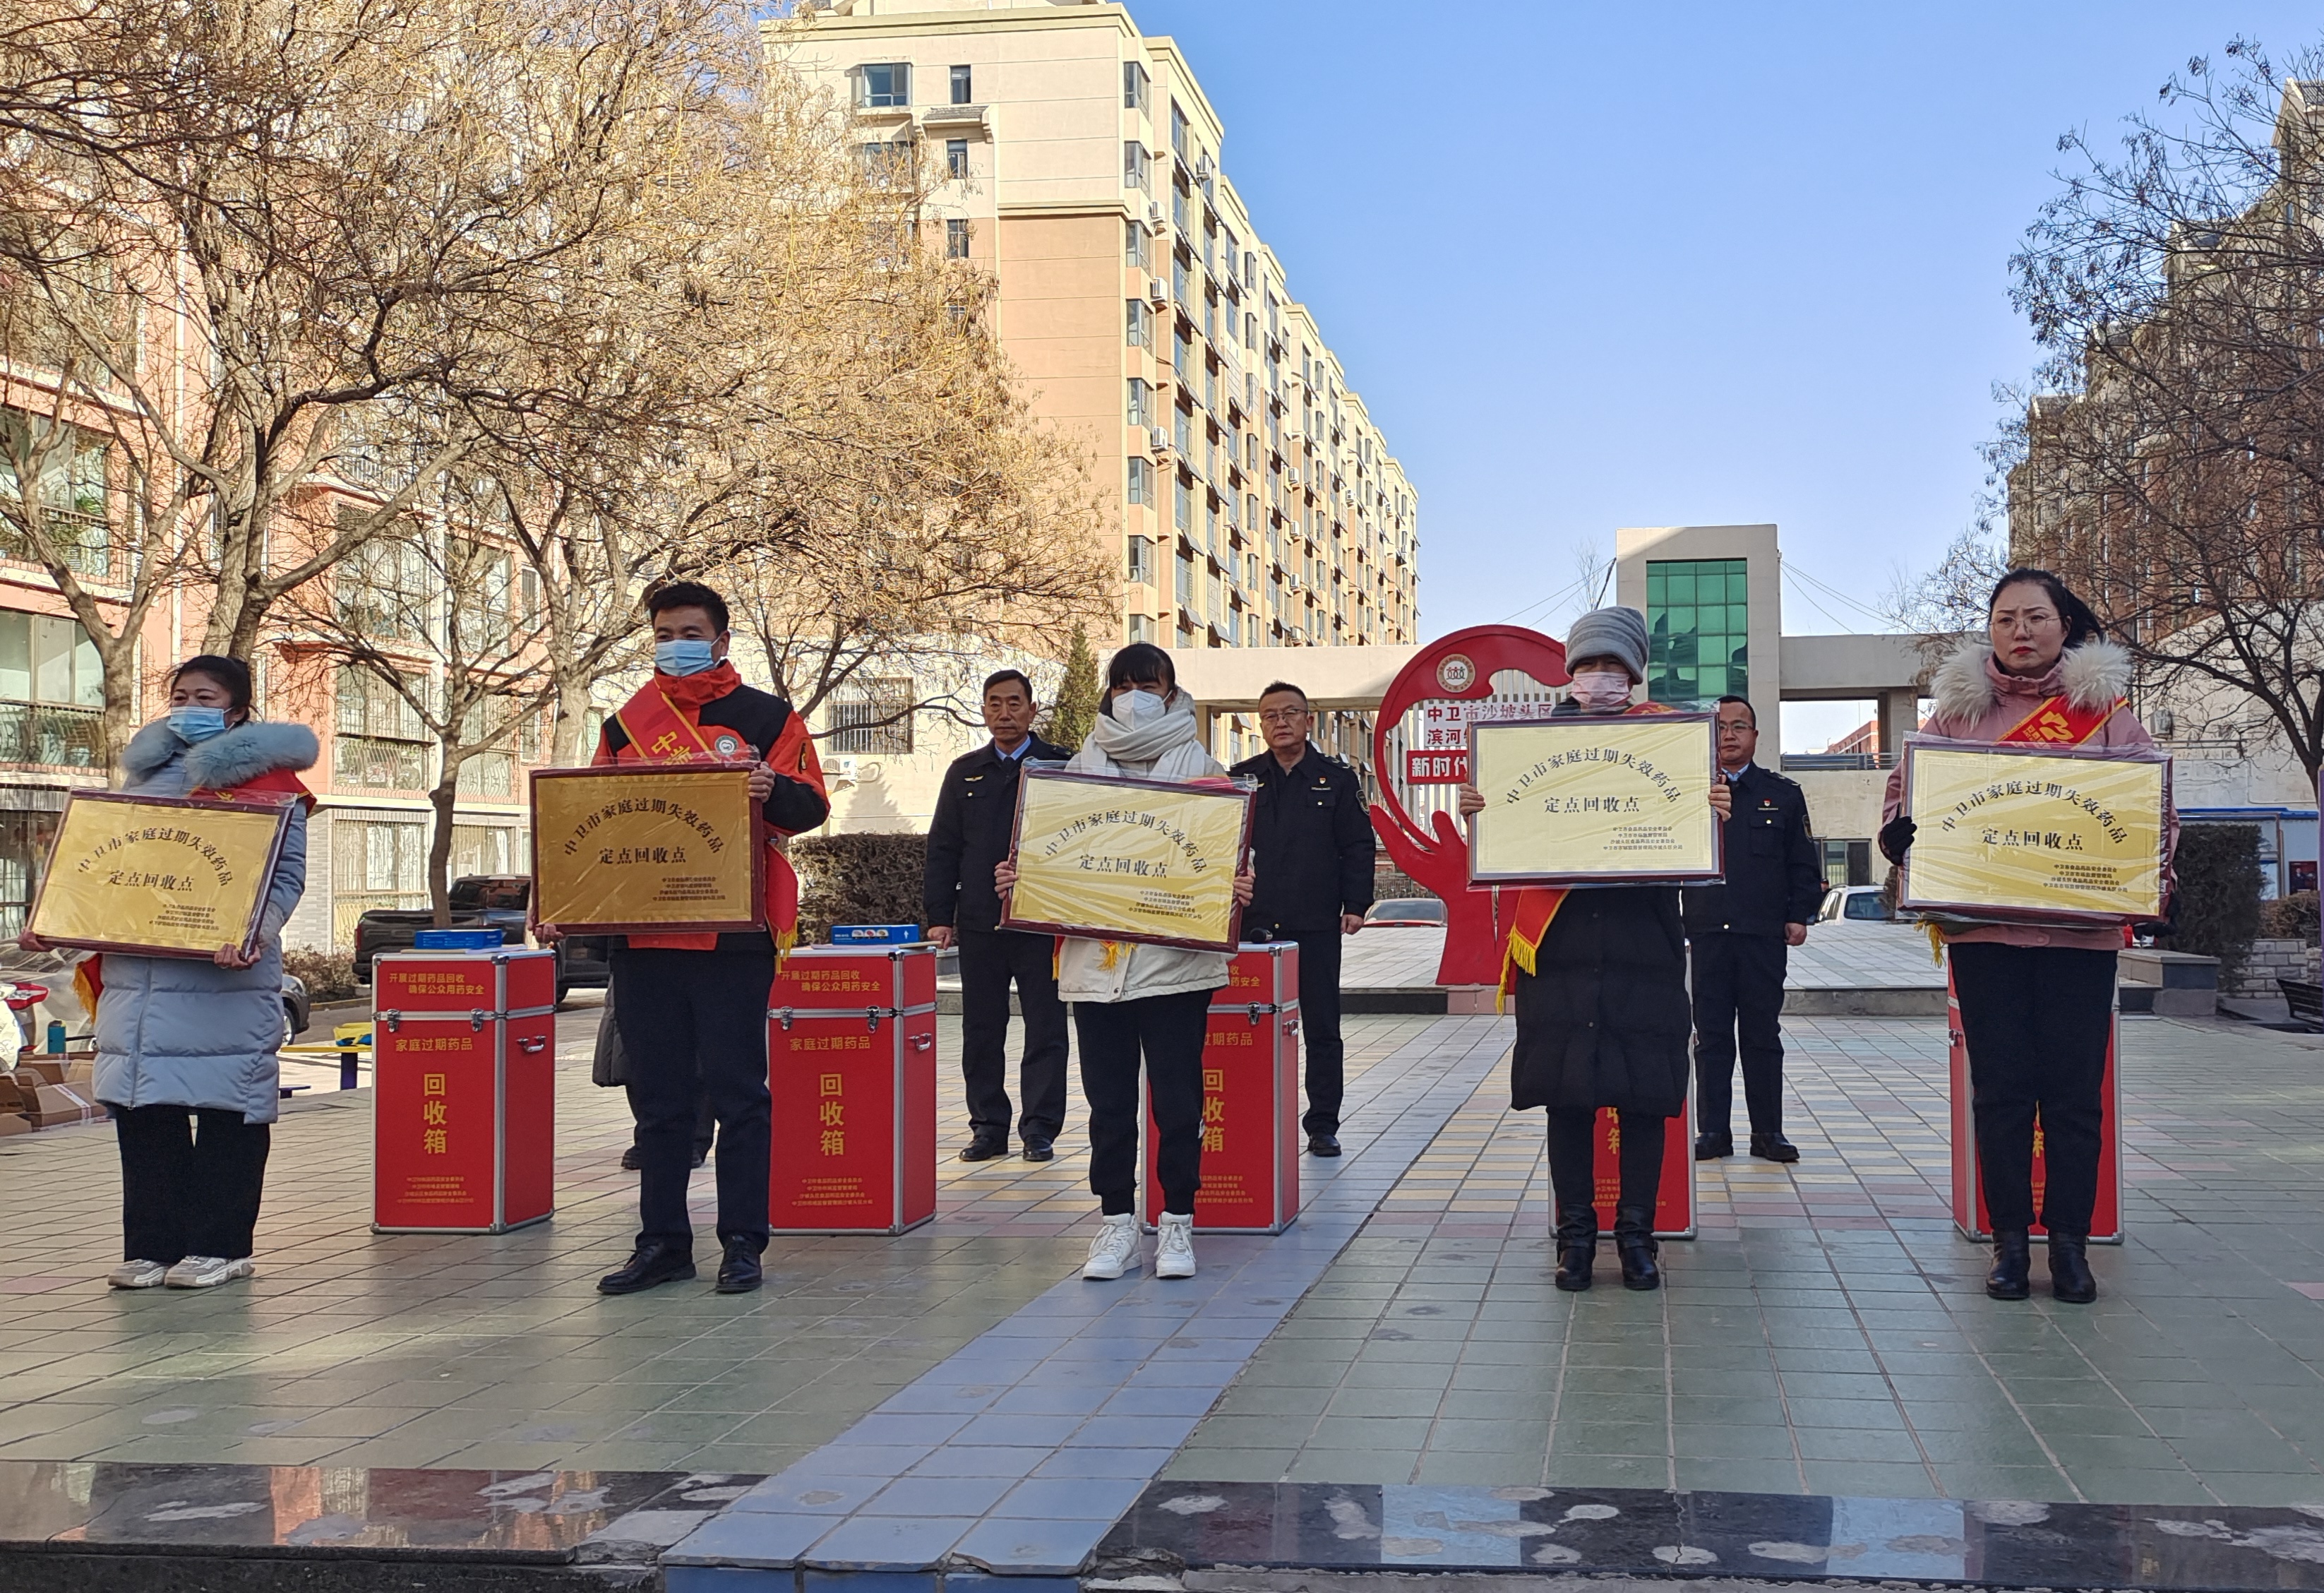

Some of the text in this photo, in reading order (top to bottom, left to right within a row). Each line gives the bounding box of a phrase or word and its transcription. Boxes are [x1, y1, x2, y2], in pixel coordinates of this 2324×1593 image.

[1427, 704, 1552, 722] 中卫市沙坡头区
[1427, 729, 1468, 745] 滨河
[1507, 748, 1681, 806] 中卫市家庭过期失效药品
[1544, 796, 1641, 813] 定点回收点
[1941, 780, 2128, 845] 中卫市家庭过期失效药品
[565, 797, 724, 857] 中卫市家庭过期失效药品
[1045, 810, 1208, 874] 中卫市家庭过期失效药品
[1981, 828, 2083, 851] 定点回收点
[78, 827, 234, 887] 中卫市家庭过期失效药品
[599, 847, 686, 864] 定点回收点
[1079, 854, 1167, 878] 定点回收点
[108, 869, 195, 892] 定点回收点
[389, 973, 465, 984] 开展过期药品回收
[780, 970, 860, 981] 开展过期药品回收
[1230, 965, 1240, 974] 收
[408, 984, 485, 996] 确保公众用药安全
[801, 981, 880, 992] 确保公众用药安全
[1230, 976, 1261, 987] 药安全
[395, 1037, 473, 1053] 家庭过期药品
[789, 1036, 871, 1051] 家庭过期药品
[424, 1073, 447, 1155] 回收箱
[820, 1073, 845, 1156] 回收箱
[1202, 1068, 1225, 1152] 回收箱
